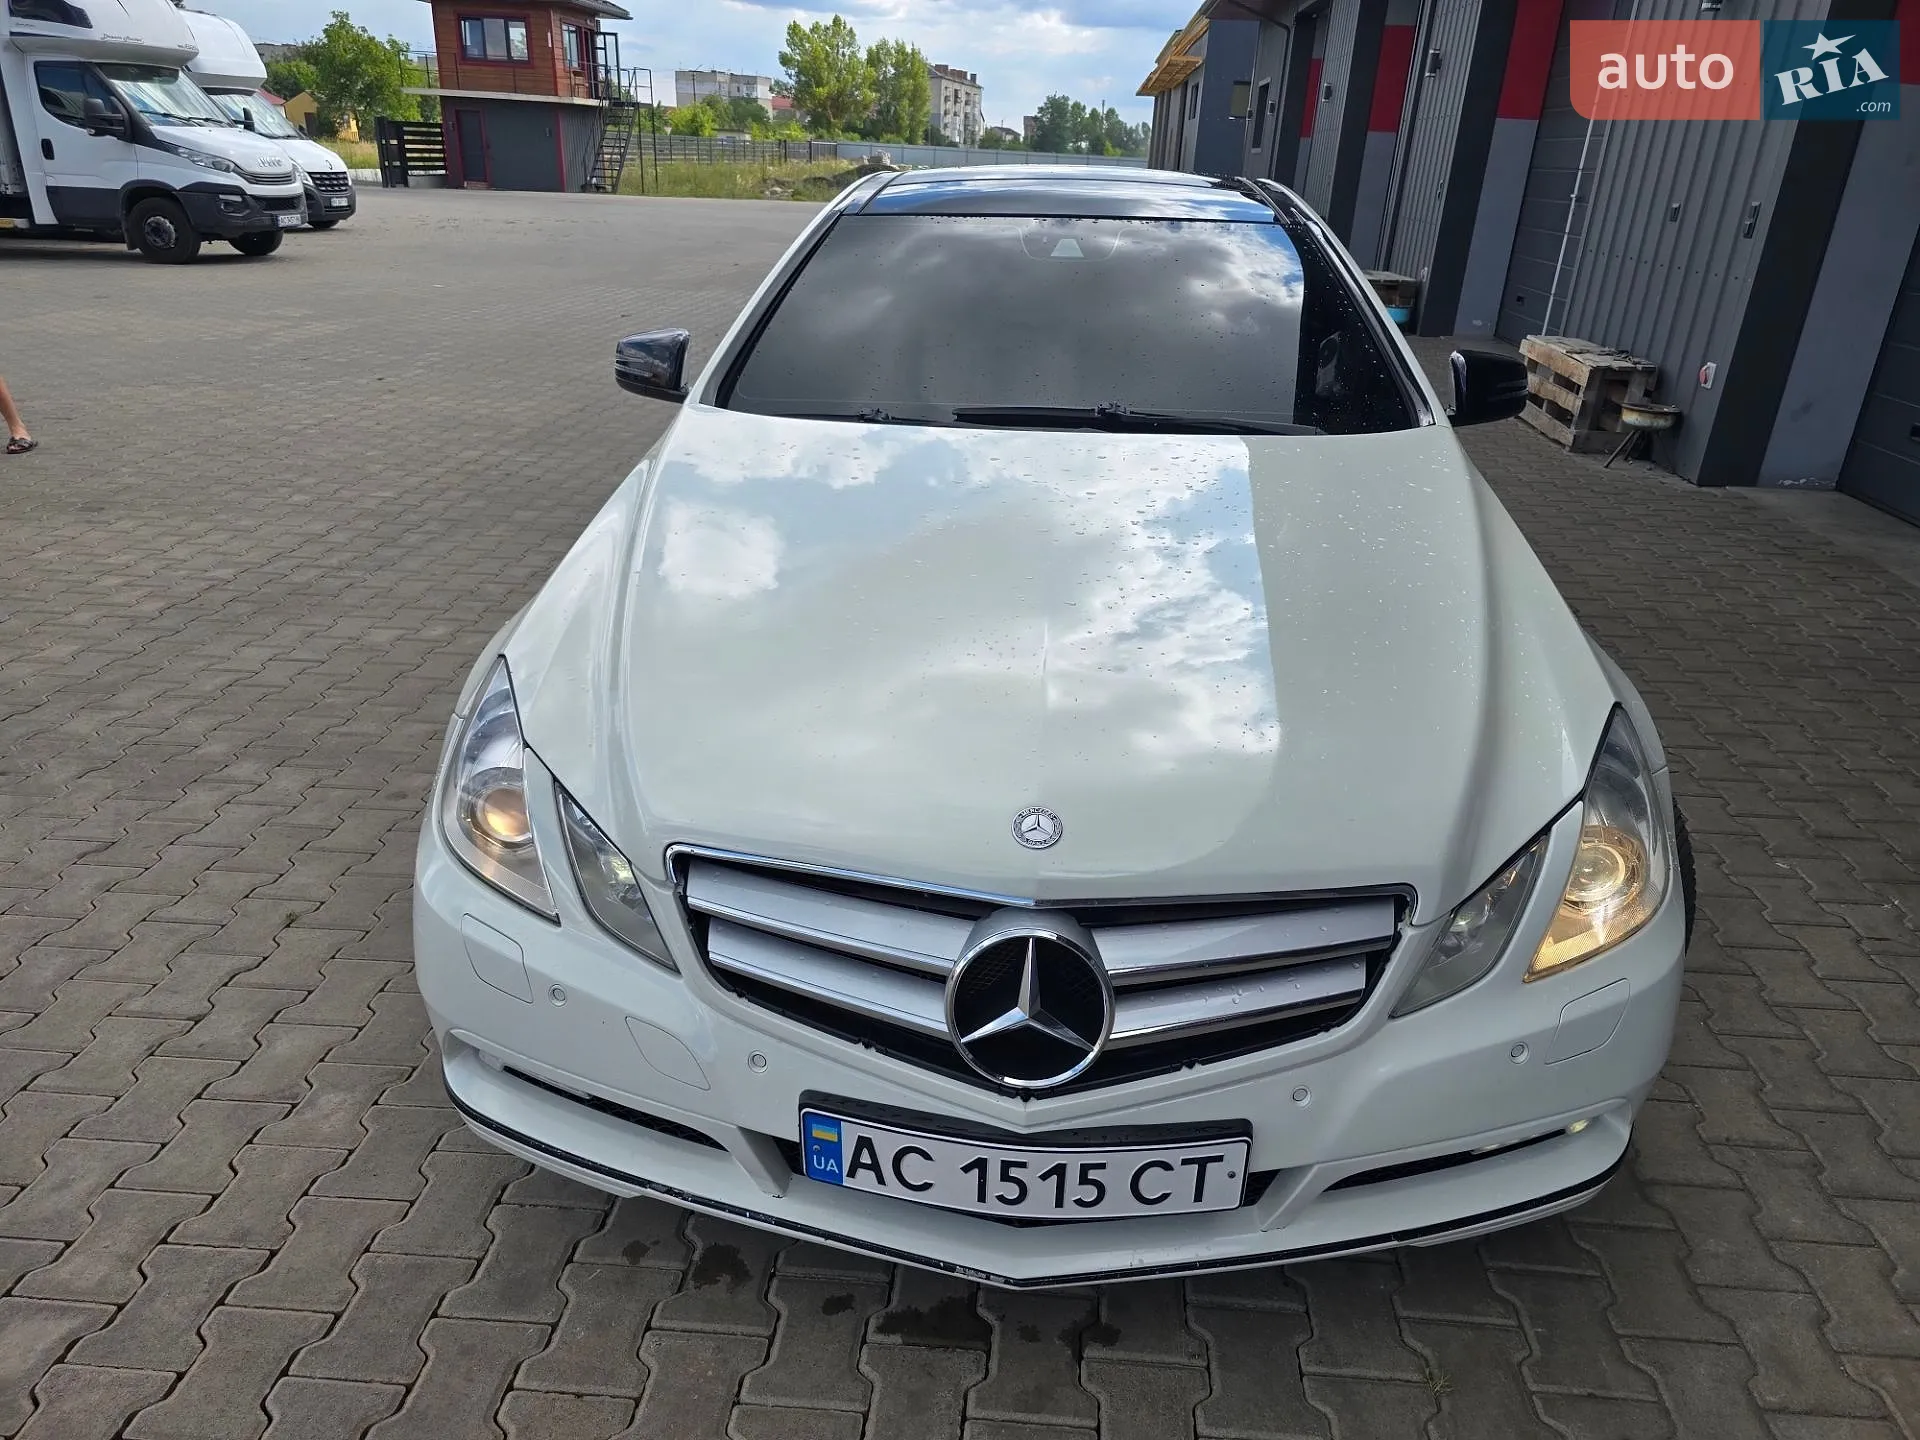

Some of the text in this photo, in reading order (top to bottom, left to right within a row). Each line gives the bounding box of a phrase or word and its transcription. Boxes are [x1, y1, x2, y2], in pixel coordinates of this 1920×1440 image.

[813, 1156, 839, 1174] UA
[845, 1134, 1225, 1209] AC 1515 CT
